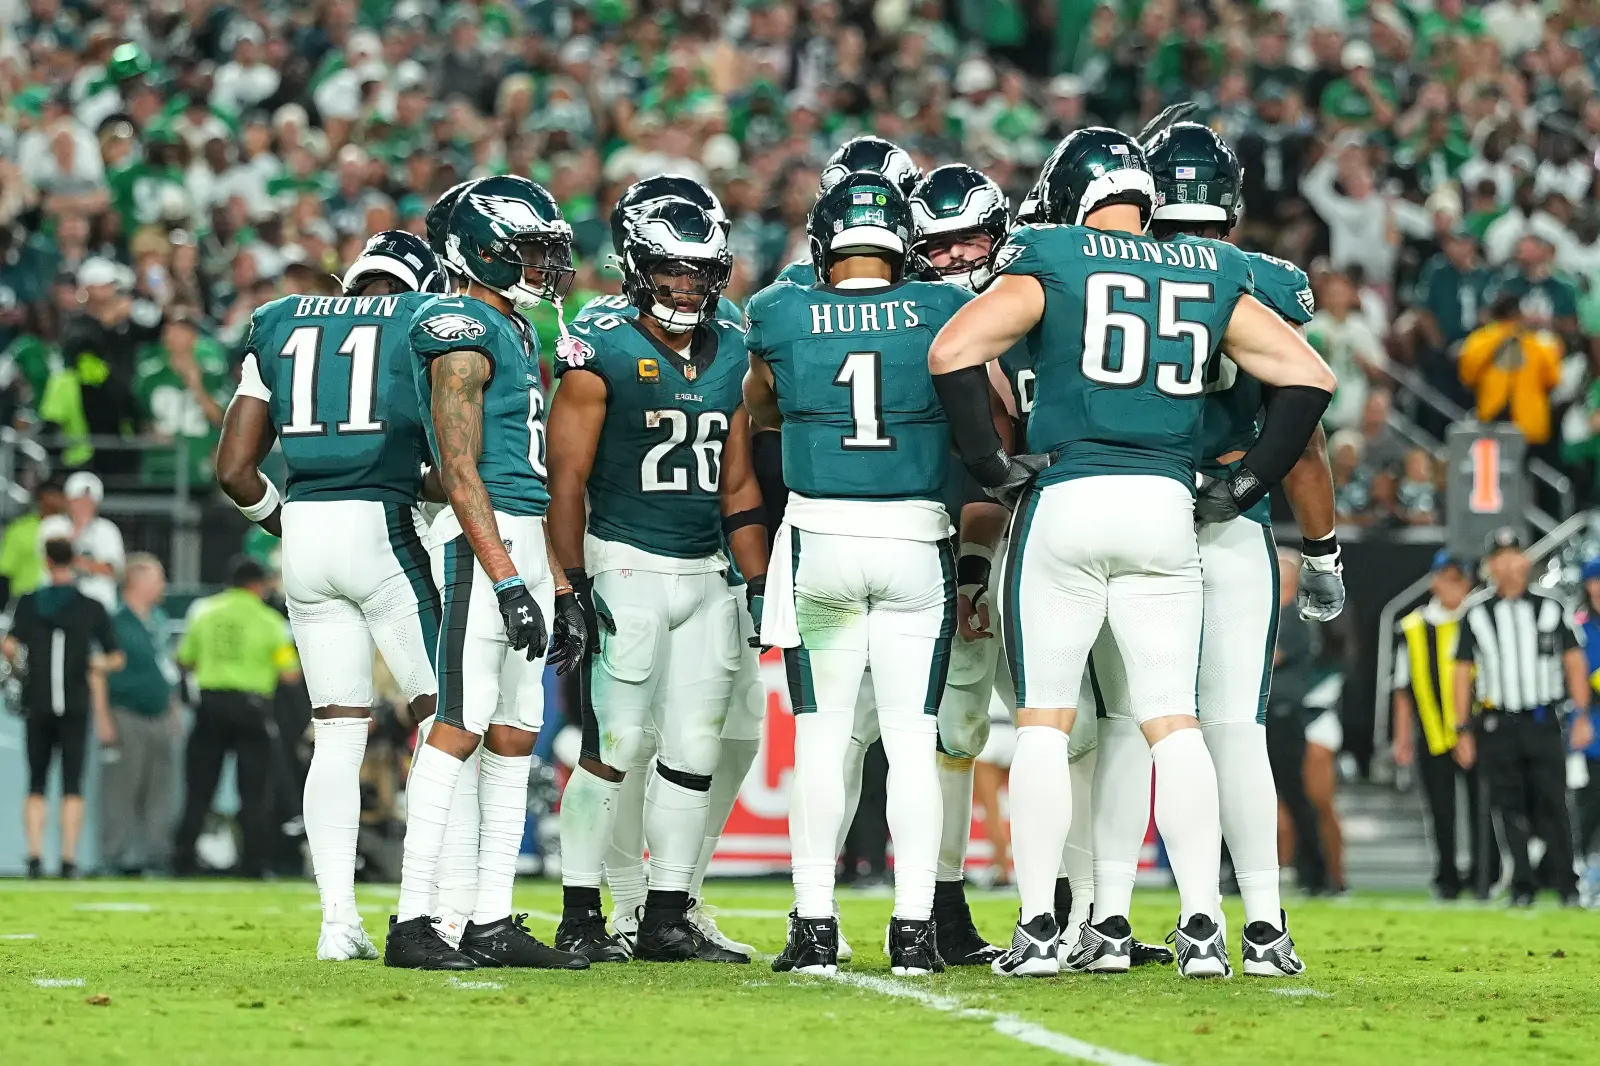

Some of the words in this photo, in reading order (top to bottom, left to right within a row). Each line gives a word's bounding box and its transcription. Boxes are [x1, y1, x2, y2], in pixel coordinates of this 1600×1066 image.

[1082, 233, 1219, 272] JOHNSON
[293, 296, 400, 317] BROWN
[809, 300, 919, 334] HURTS
[1080, 271, 1215, 399] 65
[278, 325, 388, 438] 11
[638, 359, 660, 378] C
[674, 393, 704, 402] EAGLES
[832, 351, 897, 451] 1
[526, 386, 548, 484] 6
[640, 408, 730, 494] 26
